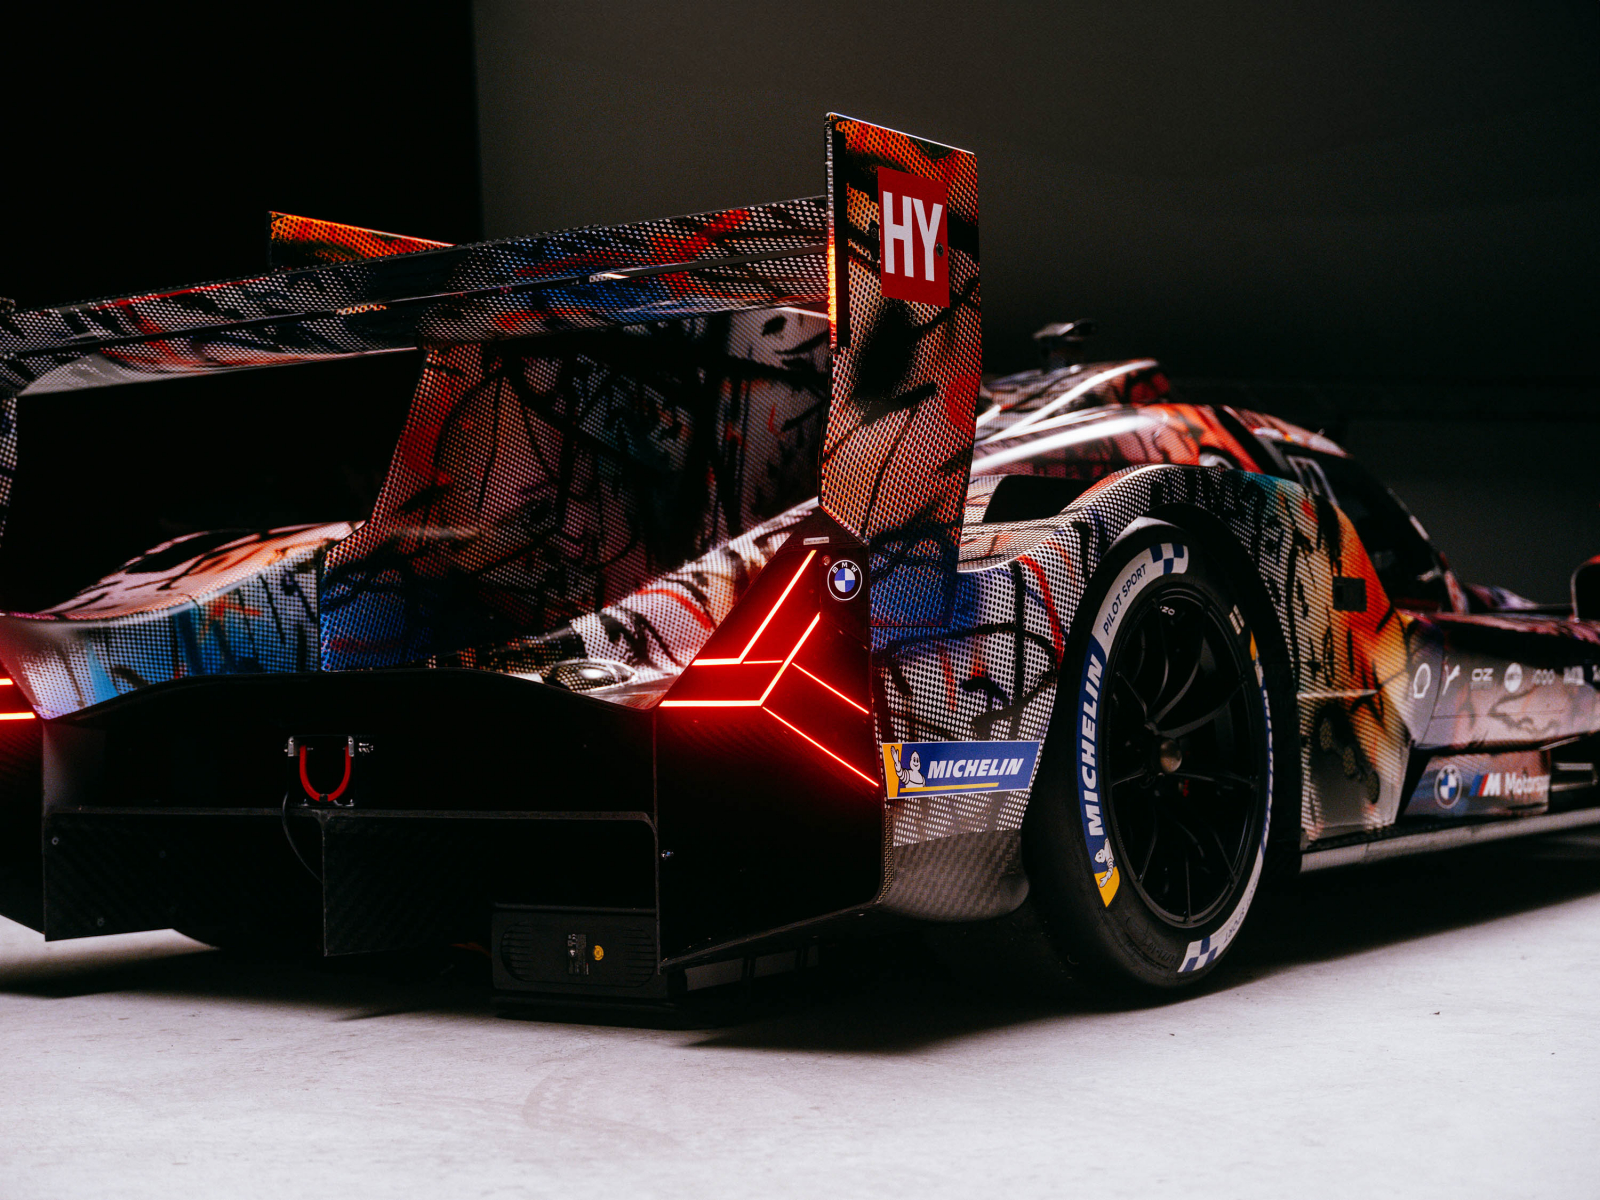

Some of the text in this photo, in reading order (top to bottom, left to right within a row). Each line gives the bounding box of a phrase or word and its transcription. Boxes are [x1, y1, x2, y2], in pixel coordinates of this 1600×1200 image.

[883, 190, 943, 282] HY
[831, 561, 858, 574] BMW
[1103, 563, 1147, 636] PILOT SPORT
[1471, 667, 1494, 682] OZ
[1081, 653, 1105, 836] MICHELIN
[927, 758, 1024, 779] MICHELIN
